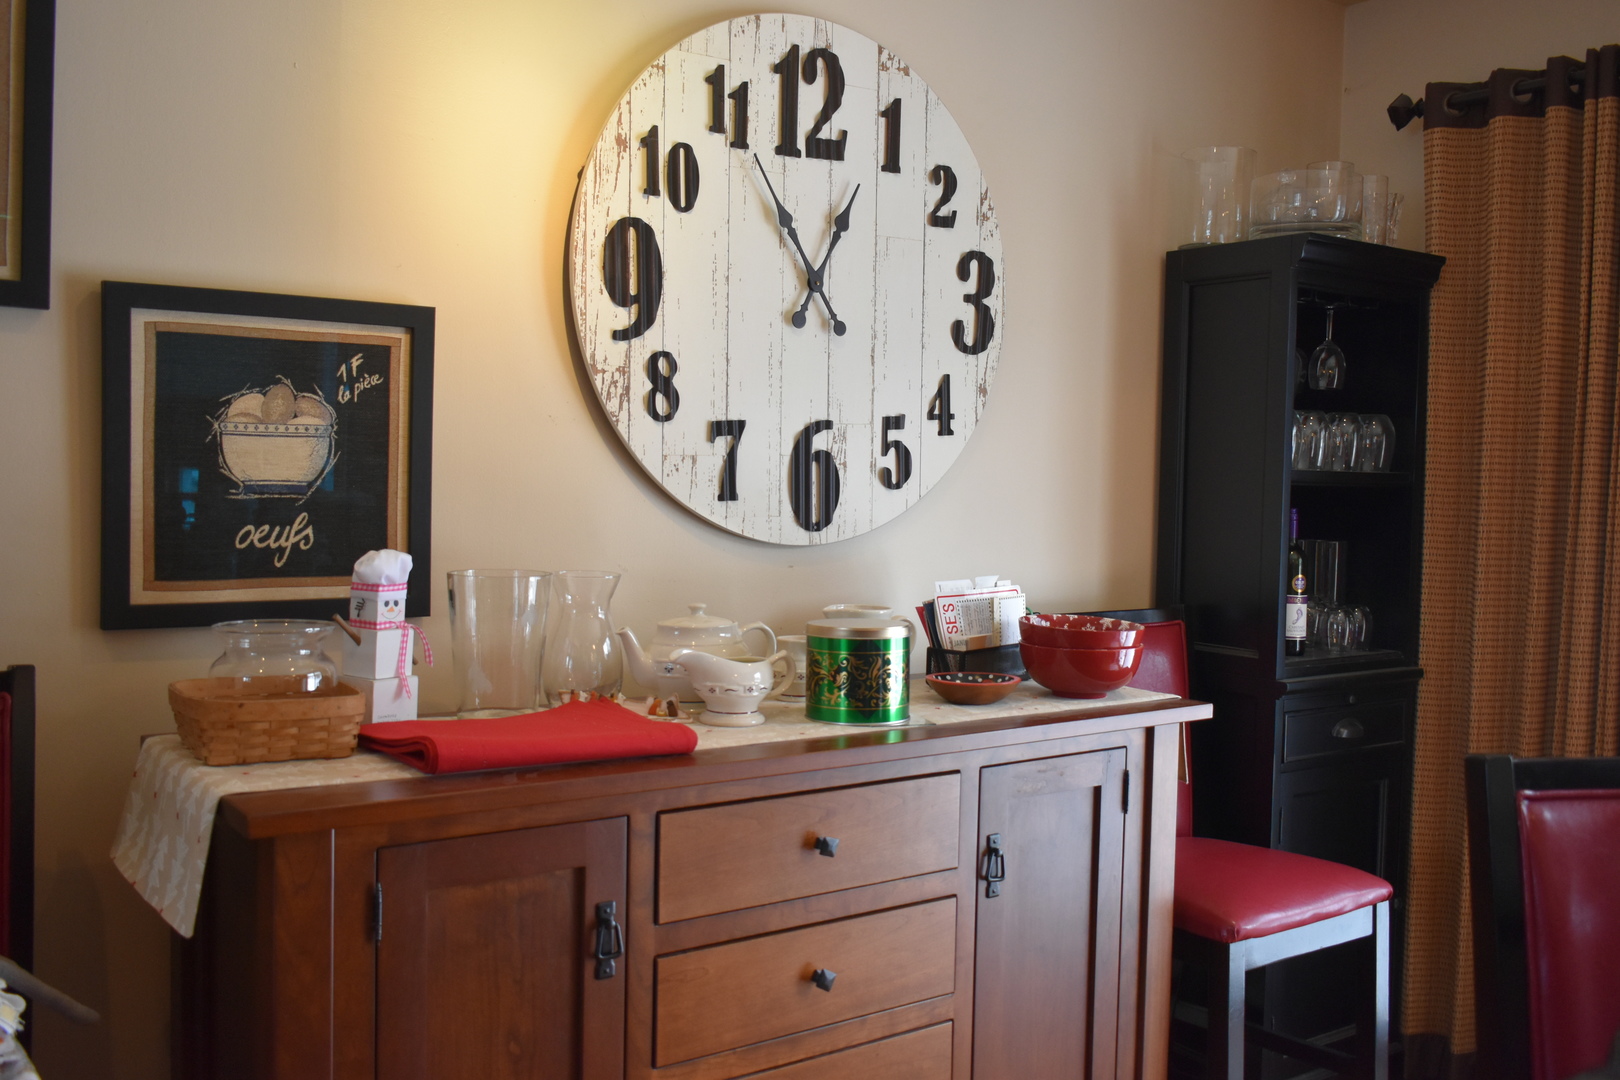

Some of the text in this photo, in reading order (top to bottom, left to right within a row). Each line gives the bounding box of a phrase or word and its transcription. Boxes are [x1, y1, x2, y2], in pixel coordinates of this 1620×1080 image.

[705, 65, 749, 149] 11
[773, 45, 847, 161] 12
[881, 98, 901, 173] 1
[641, 126, 699, 212] 10
[930, 165, 957, 228] 2
[603, 217, 662, 341] 9
[952, 251, 995, 355] 3
[336, 353, 364, 382] 1 F
[337, 385, 351, 404] la
[647, 351, 679, 422] 8
[928, 374, 954, 436] 4
[710, 420, 745, 501] 7
[790, 420, 840, 532] 6
[881, 415, 911, 489] 5
[235, 512, 314, 568] oeufs
